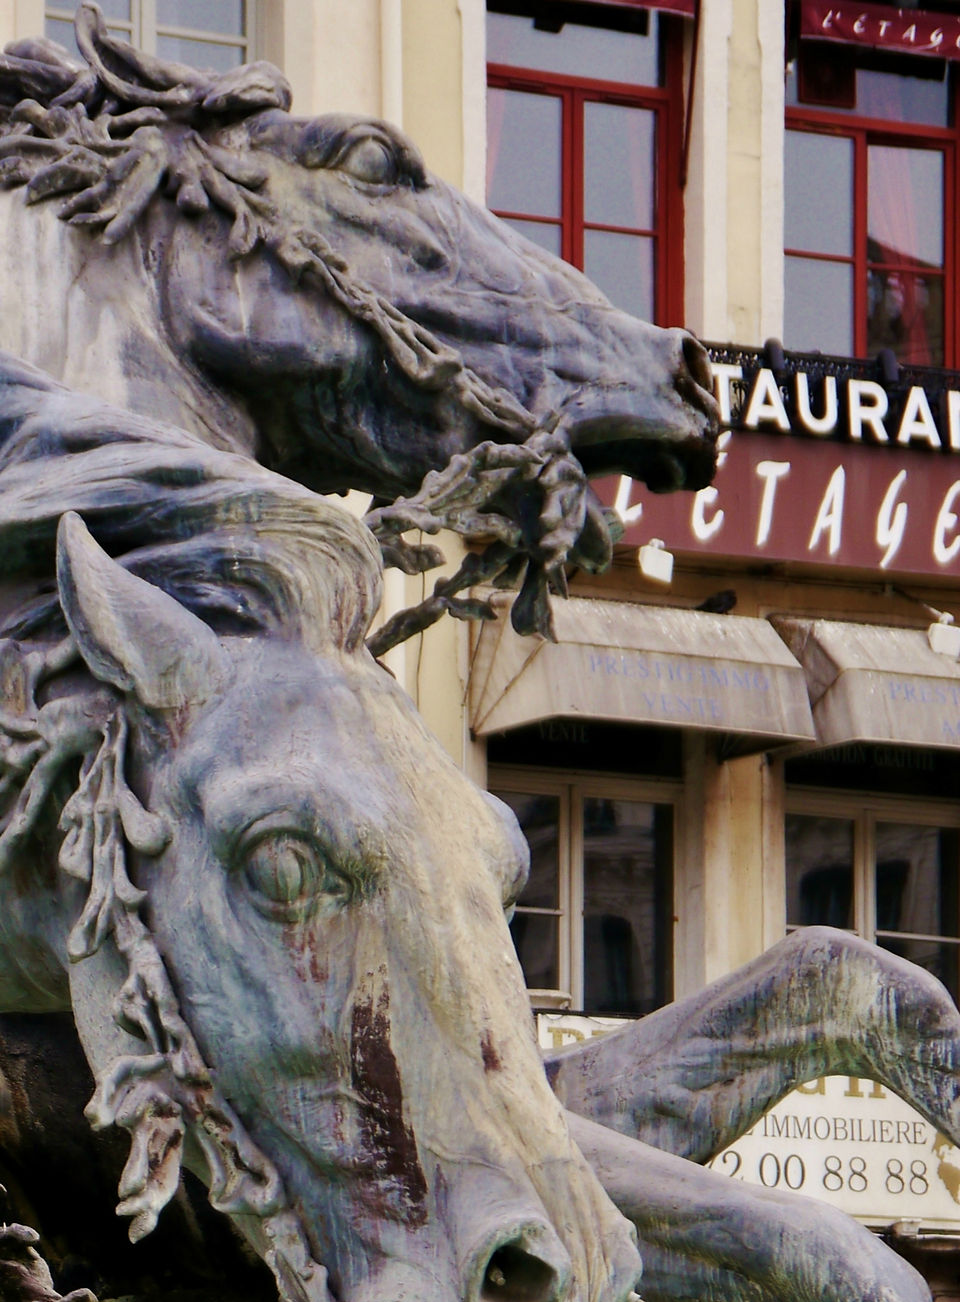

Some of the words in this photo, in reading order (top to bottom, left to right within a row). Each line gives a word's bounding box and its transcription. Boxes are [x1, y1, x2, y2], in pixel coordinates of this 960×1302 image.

[642, 693, 725, 719] VENTE
[708, 1150, 744, 1181] 2
[759, 1152, 805, 1190] 00
[823, 1155, 868, 1193] 88
[885, 1158, 929, 1195] 88
